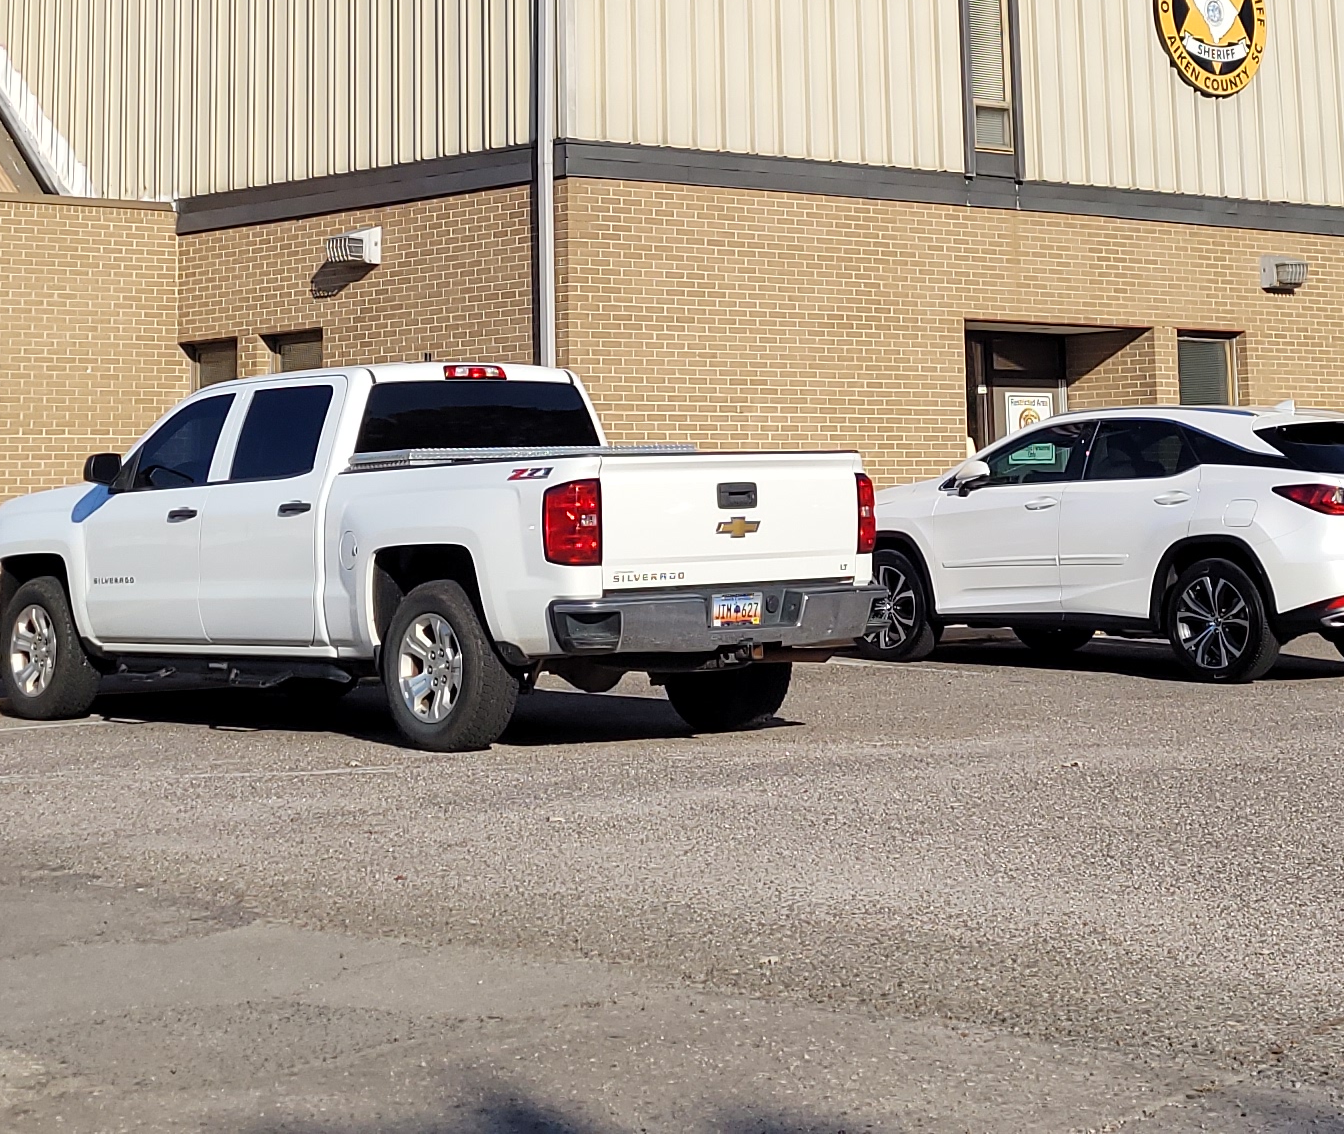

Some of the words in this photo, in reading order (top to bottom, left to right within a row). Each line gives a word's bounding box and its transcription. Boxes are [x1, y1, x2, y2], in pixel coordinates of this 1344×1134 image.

[1197, 44, 1235, 60] SHERIFF
[1167, 36, 1200, 82] AIKEN
[1204, 66, 1250, 91] COUNTY
[1252, 43, 1263, 64] SC
[507, 467, 554, 481] Z71
[93, 576, 135, 585] SILVERADO
[612, 571, 685, 583] SILVERADO
[741, 602, 759, 618] 627
